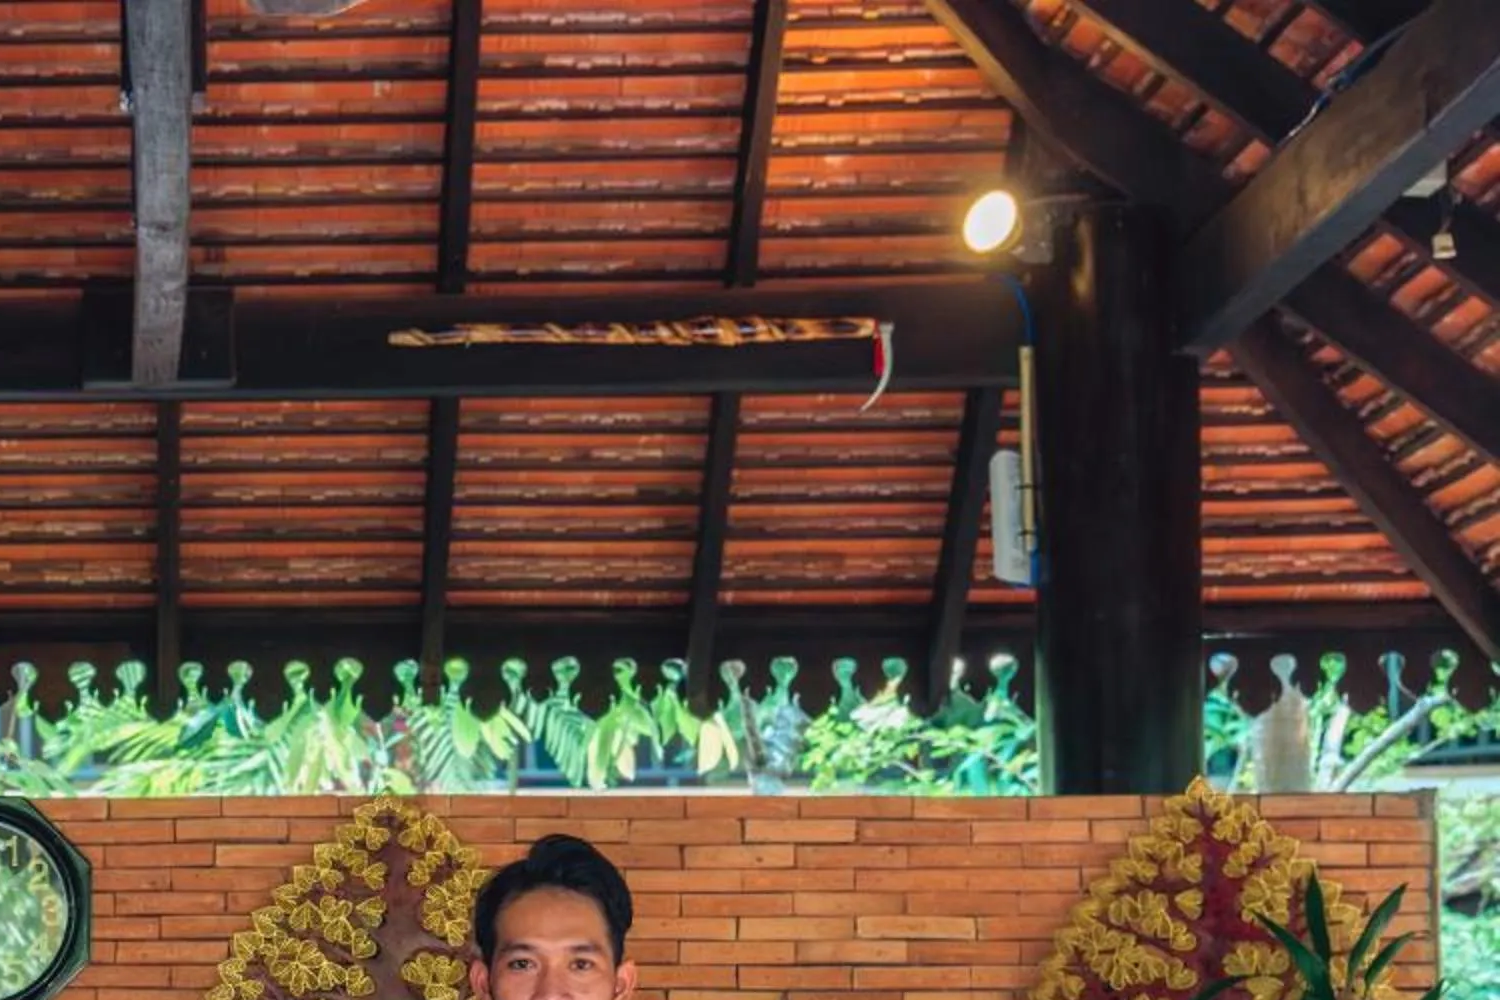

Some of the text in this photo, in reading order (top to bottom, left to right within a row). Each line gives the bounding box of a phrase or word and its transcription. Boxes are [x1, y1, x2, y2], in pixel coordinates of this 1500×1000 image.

[4, 835, 19, 867] 1
[27, 861, 50, 892] 2
[40, 896, 62, 928] 3
[27, 934, 52, 961] 4
[3, 960, 24, 989] 5
